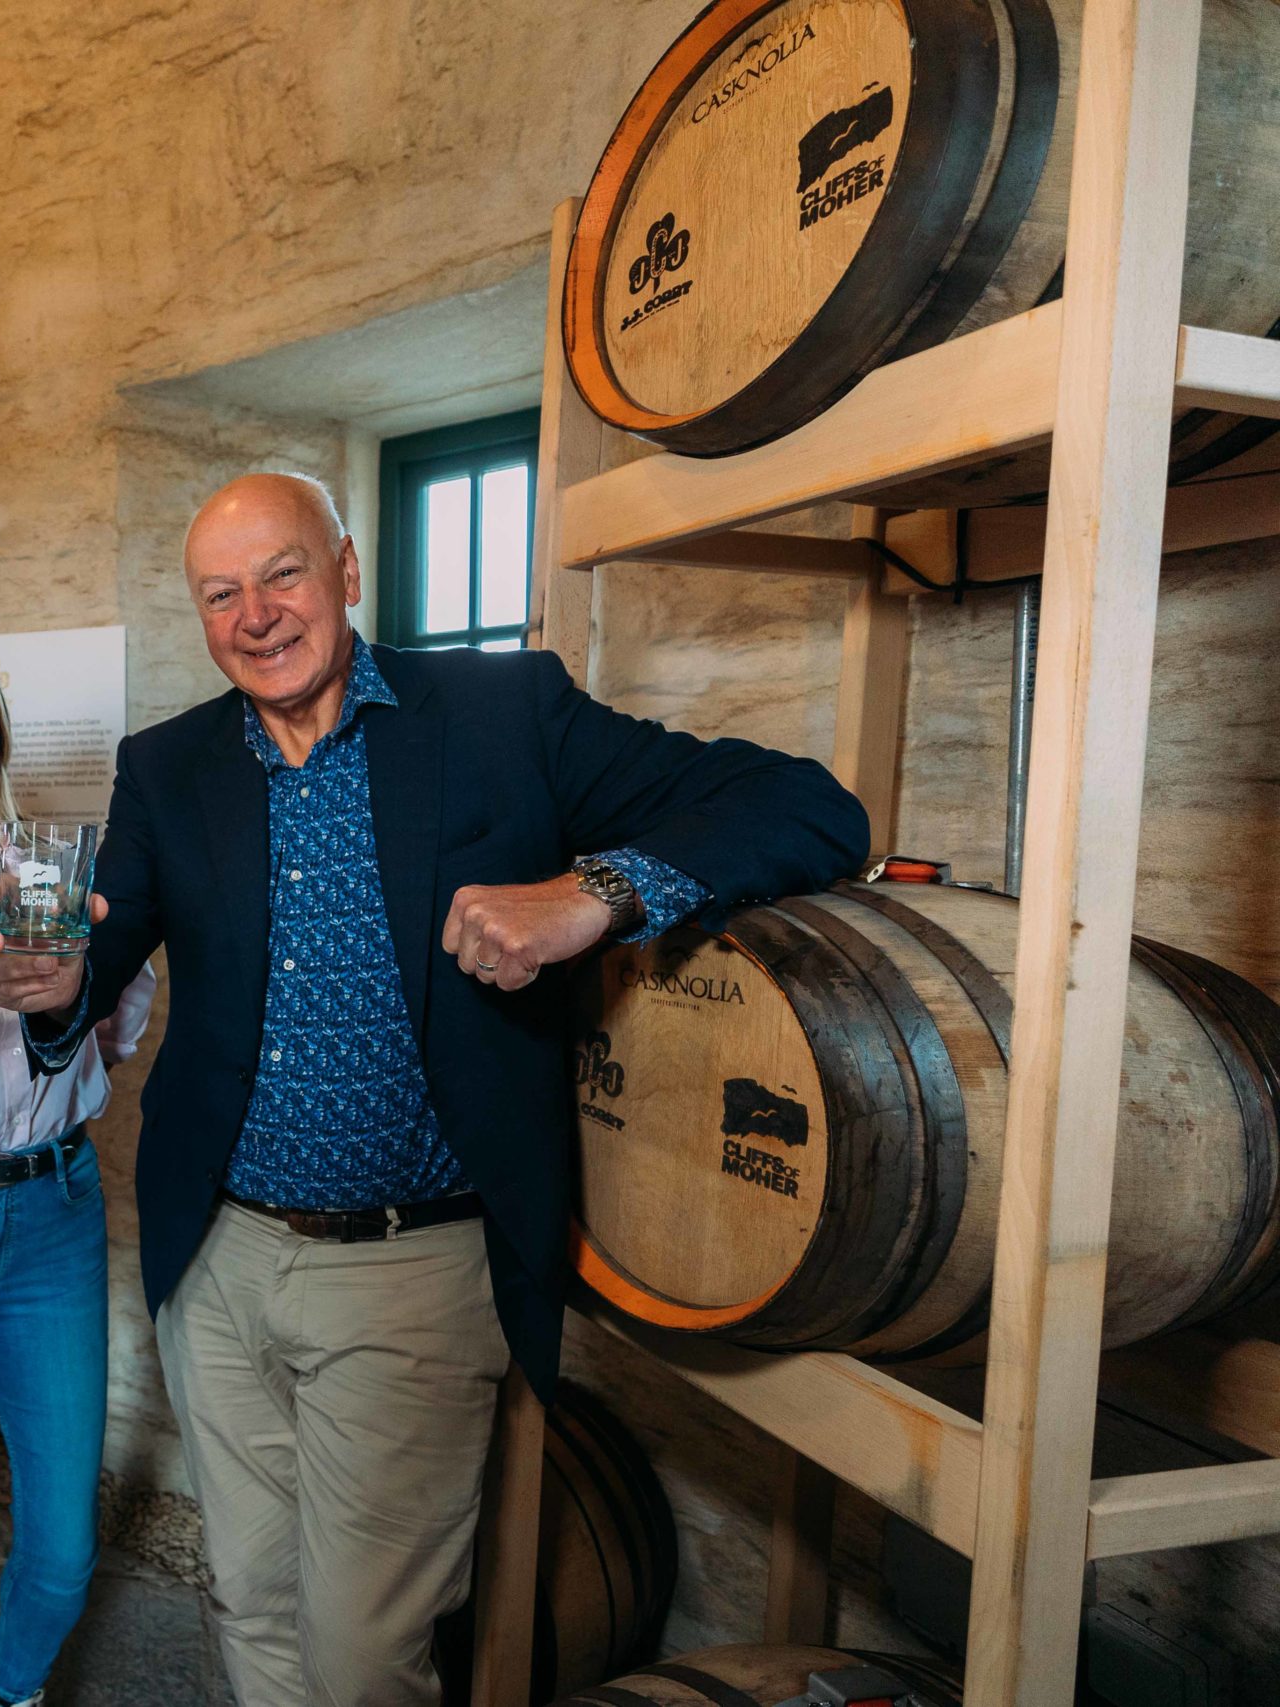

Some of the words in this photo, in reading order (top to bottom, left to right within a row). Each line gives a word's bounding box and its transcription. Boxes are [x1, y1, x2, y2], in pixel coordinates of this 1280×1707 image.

[692, 23, 816, 124] CASKNOLIA
[799, 169, 884, 231] MOHER
[801, 160, 868, 210] CLIFFS
[867, 154, 886, 173] OF
[644, 280, 693, 313] CORRY
[21, 898, 59, 906] MOHER
[621, 968, 745, 1005] CASKNOLIA
[721, 1155, 799, 1200] MOHER
[723, 1140, 785, 1173] CLIFFS
[784, 1166, 800, 1178] OF
